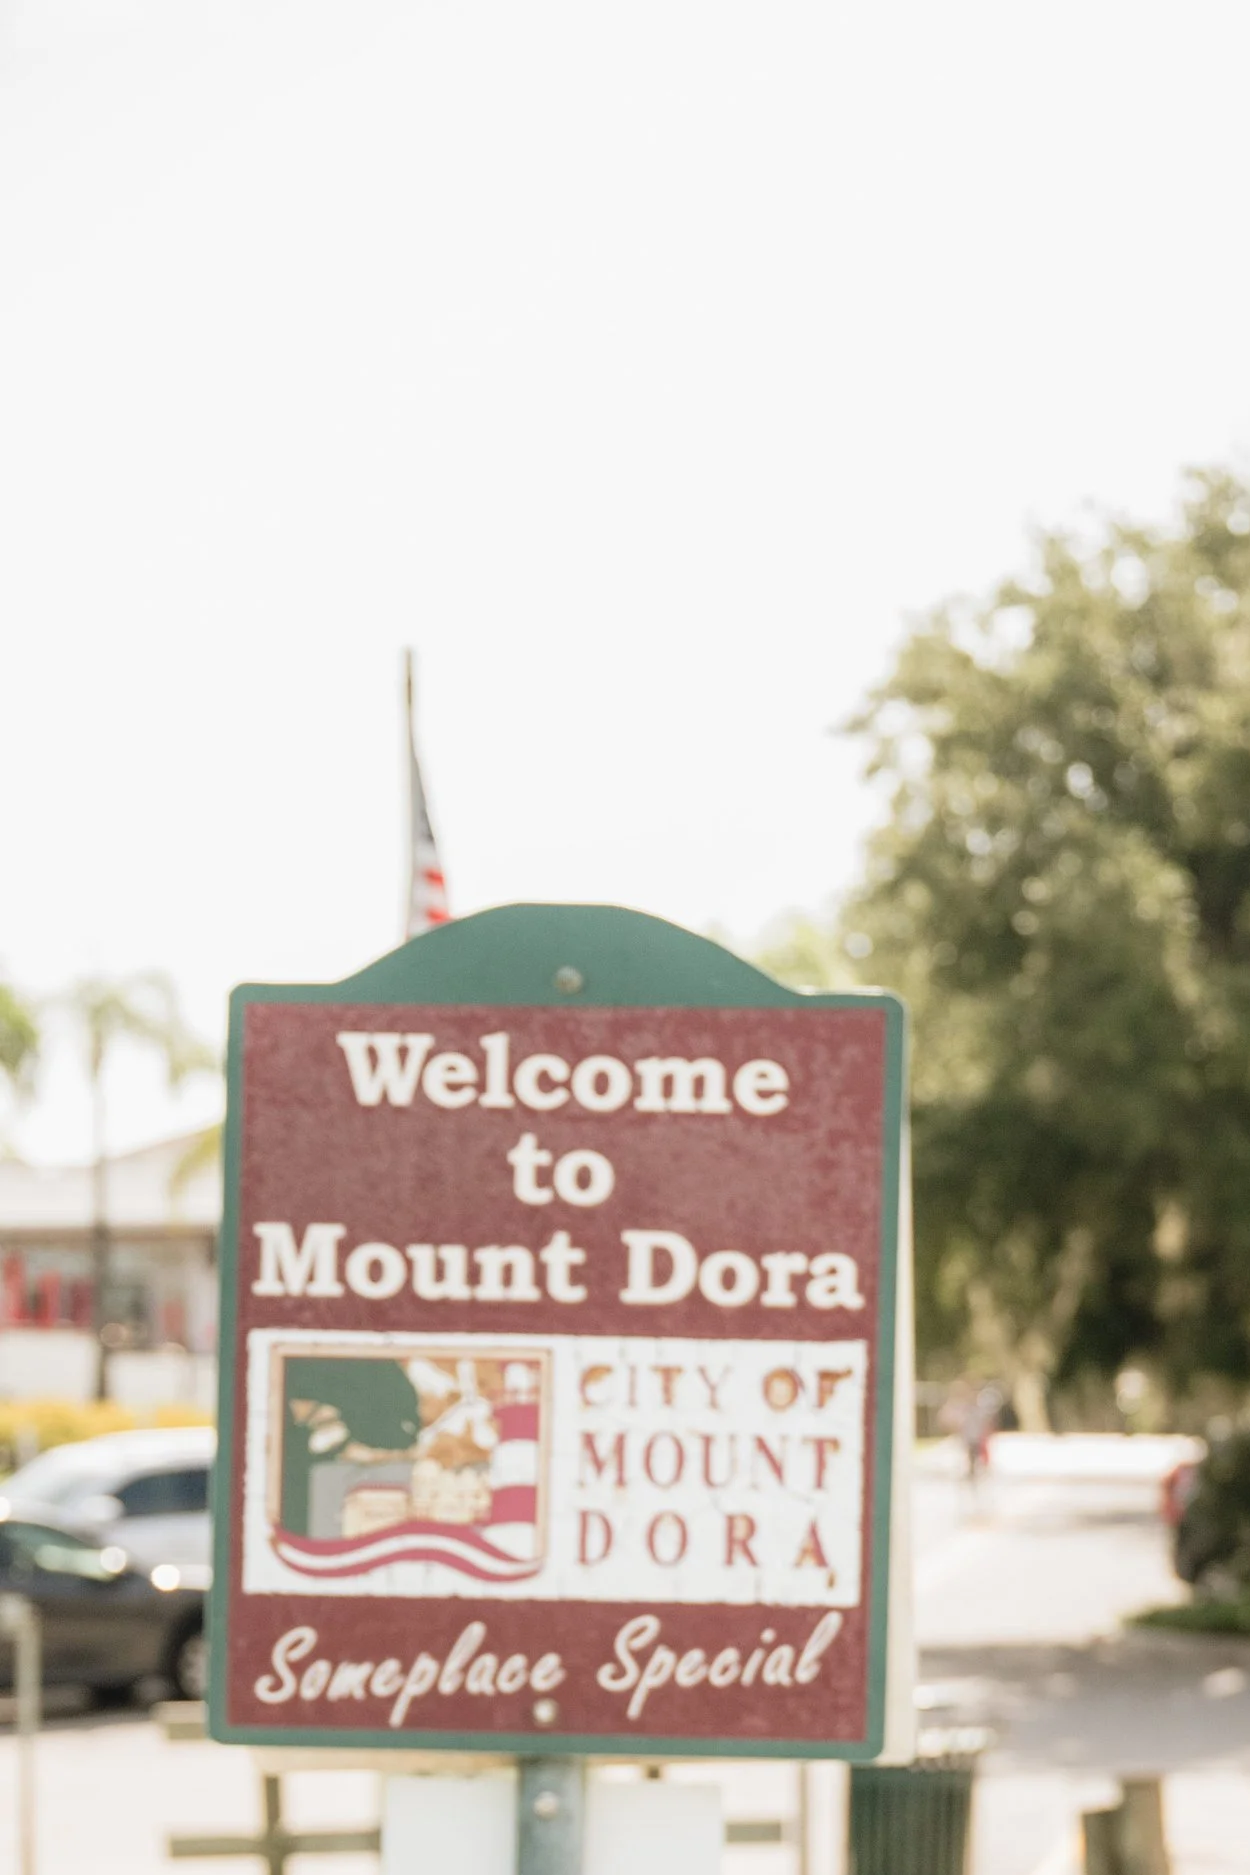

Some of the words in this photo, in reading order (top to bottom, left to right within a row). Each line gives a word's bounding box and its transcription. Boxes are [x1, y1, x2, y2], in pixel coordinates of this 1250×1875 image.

[335, 1031, 789, 1115] Welcome
[507, 1132, 615, 1207] to
[252, 1221, 587, 1303] Mount
[619, 1229, 865, 1310] Dora
[578, 1363, 733, 1411] CITY
[760, 1366, 853, 1412] OF
[577, 1430, 842, 1491] MOUNT
[576, 1508, 830, 1569] DORA
[255, 1622, 565, 1727] Someplace
[596, 1610, 842, 1719] Special
